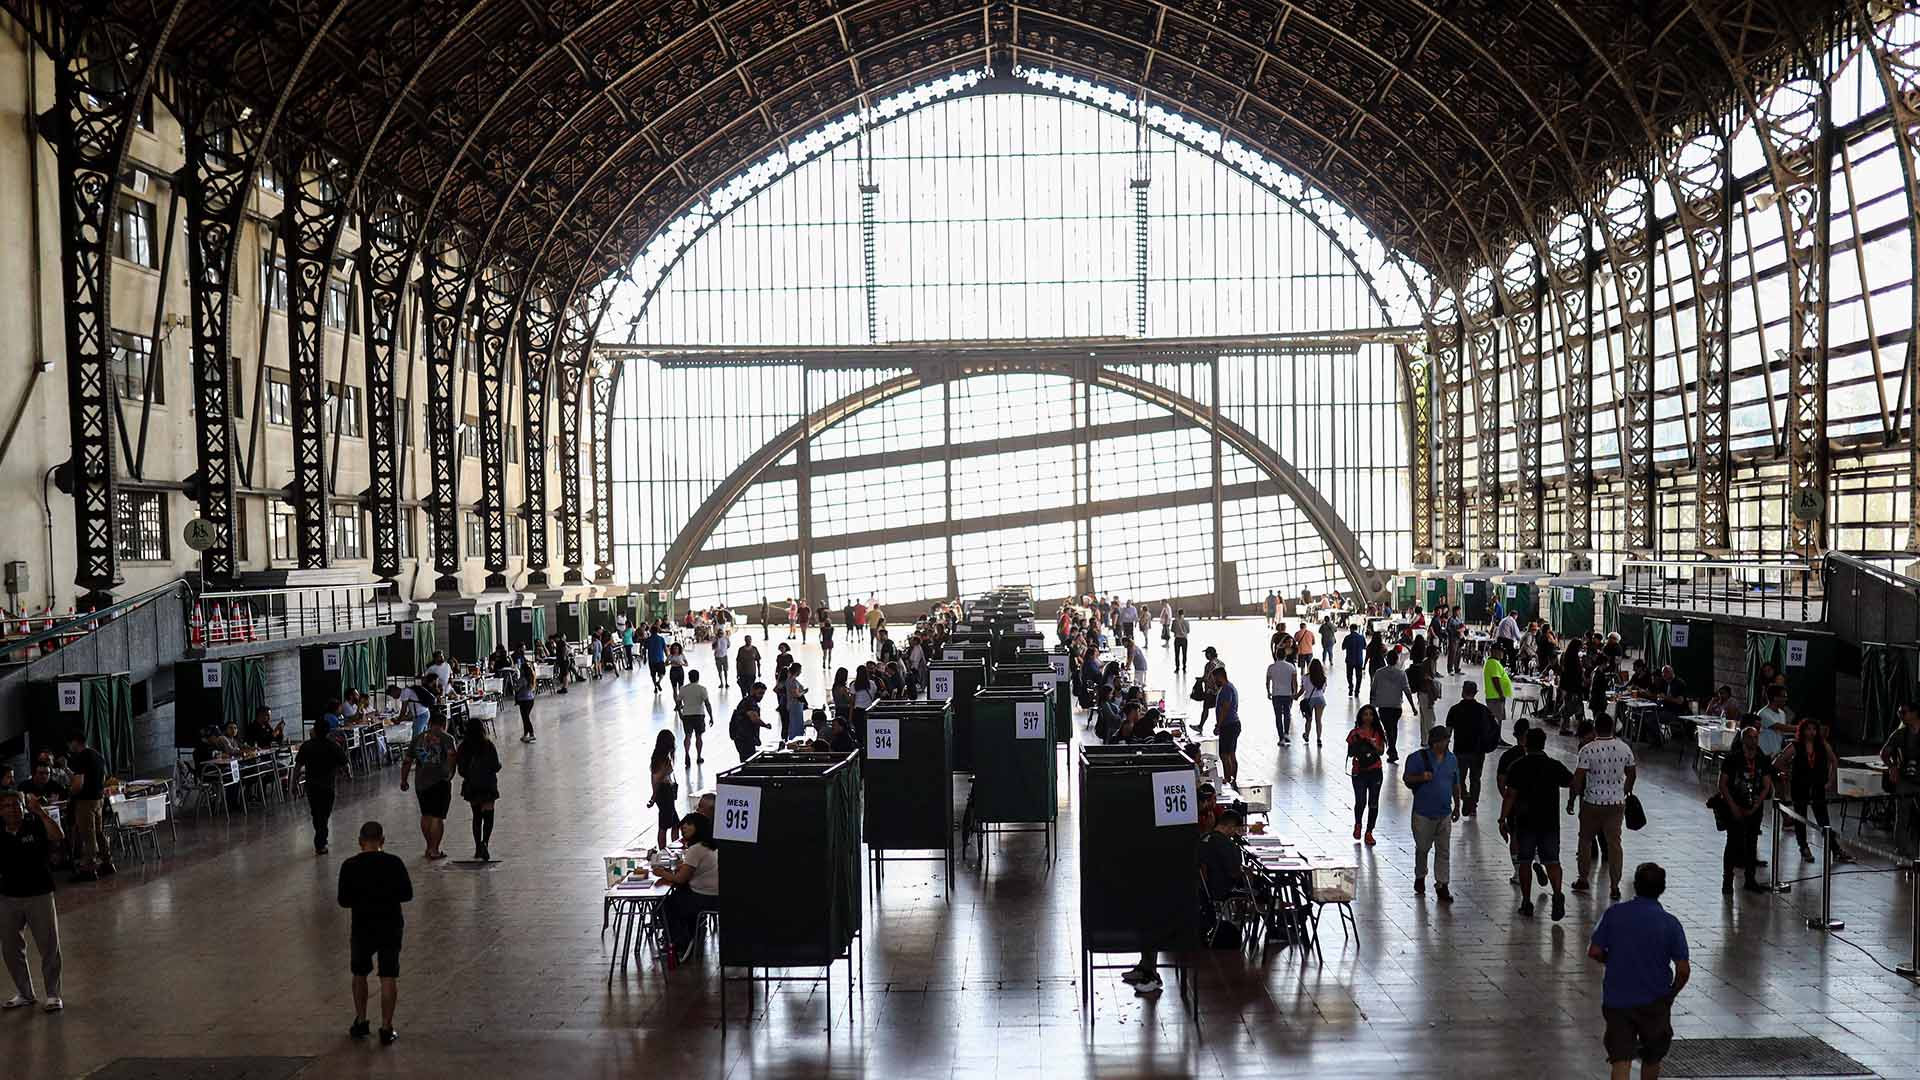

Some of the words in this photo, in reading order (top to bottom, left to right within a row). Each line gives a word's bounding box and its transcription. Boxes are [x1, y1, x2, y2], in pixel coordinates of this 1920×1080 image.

[1792, 652, 1802, 662] 938
[936, 683, 948, 692] 913
[64, 696, 76, 704] 892
[1024, 718, 1038, 730] 917
[876, 736, 892, 748] 914
[1164, 784, 1186, 795] MESA
[727, 798, 749, 807] MESA
[1165, 794, 1187, 813] 916
[726, 809, 749, 830] 915
